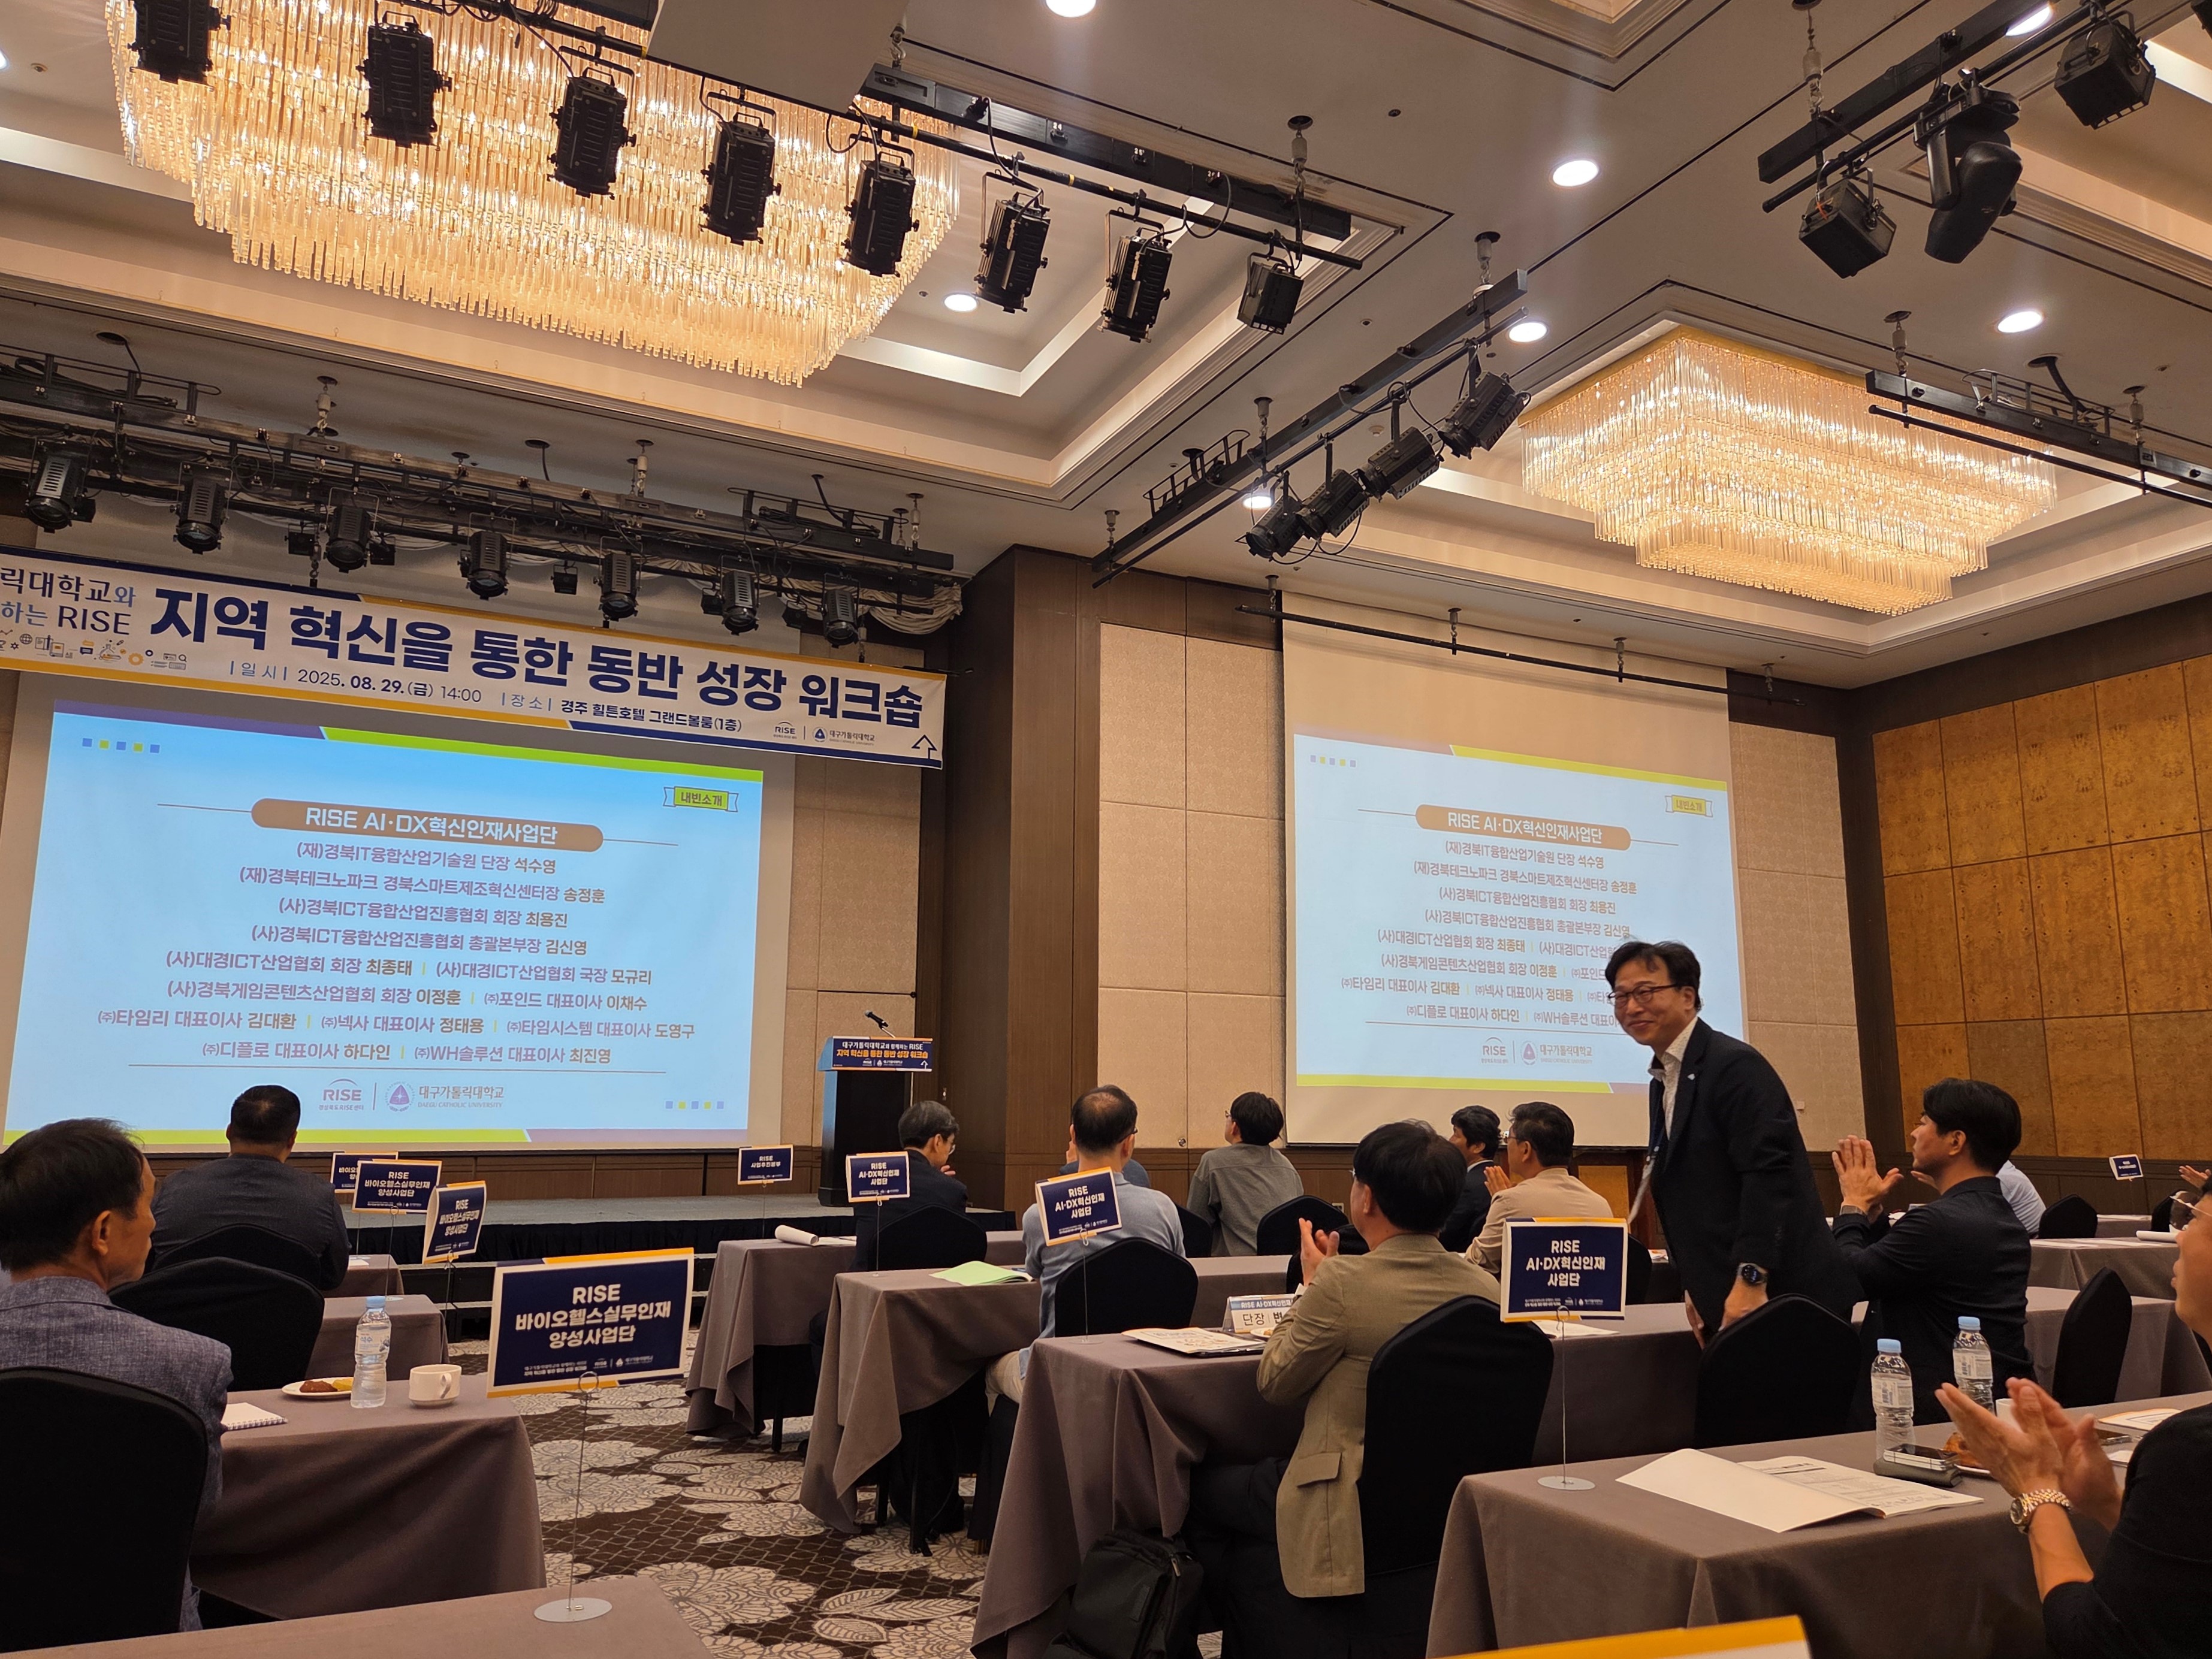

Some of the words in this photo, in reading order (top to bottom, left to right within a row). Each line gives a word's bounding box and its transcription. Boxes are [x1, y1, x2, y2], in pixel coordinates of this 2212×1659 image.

[58, 605, 131, 635] RISE
[150, 588, 269, 651] 지역
[290, 605, 452, 673] 혁신을
[470, 630, 573, 687] 통한
[587, 646, 684, 700] 동반
[696, 660, 787, 711] 성장
[799, 675, 923, 728] 워크숍
[441, 686, 481, 702] 14:00
[561, 700, 587, 714] 경주
[592, 703, 644, 721] 힐튼호텔
[648, 711, 741, 731] 그랜드볼룸(1층)
[775, 726, 795, 735] RISE
[681, 792, 722, 807] 내빈소개
[306, 807, 358, 828] RISE
[1448, 812, 1480, 829] RISE
[297, 842, 476, 868] (재)경북IT융합산업기술원
[481, 855, 510, 871] 단장
[514, 857, 556, 874] 석수영
[240, 867, 378, 889] (재)경북테크노파크
[383, 876, 560, 900] 경북스마트제조혁신센터장
[563, 887, 605, 903] 송정훈
[279, 898, 488, 922] (사)경북ICT융합산업진흥협회
[493, 909, 522, 925] 회장
[525, 912, 567, 927] 최용진
[251, 926, 464, 948] (사)경북ICT융합산업진흥협회
[468, 936, 542, 953] 총괄본부장
[545, 939, 586, 955] 김신영
[166, 951, 325, 971] (사)대경ICT산업협회
[330, 957, 362, 974] 회장
[366, 959, 412, 975] 최종태
[436, 962, 575, 981] (사)대경ICT산업협회
[580, 968, 608, 983] 국장
[611, 969, 651, 984] 모규리
[167, 981, 375, 1002] (사)경북게임콘텐츠산업협회
[380, 987, 412, 1004] 회장
[416, 989, 461, 1005] 이정훈
[547, 993, 602, 1009] 대표이사
[606, 995, 647, 1010] 이채수
[174, 1011, 243, 1028] 대표이사
[248, 1013, 297, 1029] 김대환
[373, 1016, 435, 1032] 대표이사
[439, 1017, 484, 1033] 정태용
[596, 1022, 651, 1037] 대표이사
[654, 1023, 695, 1038] 도영구
[274, 1042, 339, 1059] 대표이사
[343, 1044, 390, 1060] 하다인
[508, 1047, 565, 1062] 대표이사
[569, 1048, 610, 1063] 최진영
[1482, 1045, 1506, 1056] RISE
[322, 1089, 361, 1101] RISE
[418, 1086, 503, 1099] 대구가톨릭대학교
[388, 1171, 409, 1180] RISE
[378, 1189, 415, 1197] 양성사업단
[1068, 1186, 1088, 1198] RISE
[455, 1199, 469, 1210] RISE
[1071, 1206, 1092, 1219] 사업단
[1551, 1240, 1580, 1253] RISE
[1526, 1256, 1606, 1271] AI·DX혁신인재
[1547, 1273, 1580, 1287] 사업단
[572, 1284, 621, 1304] RISE
[515, 1301, 671, 1331] 바이오헬스실무인재
[1242, 1313, 1265, 1326] 단장
[549, 1325, 636, 1349] 양성사업단
